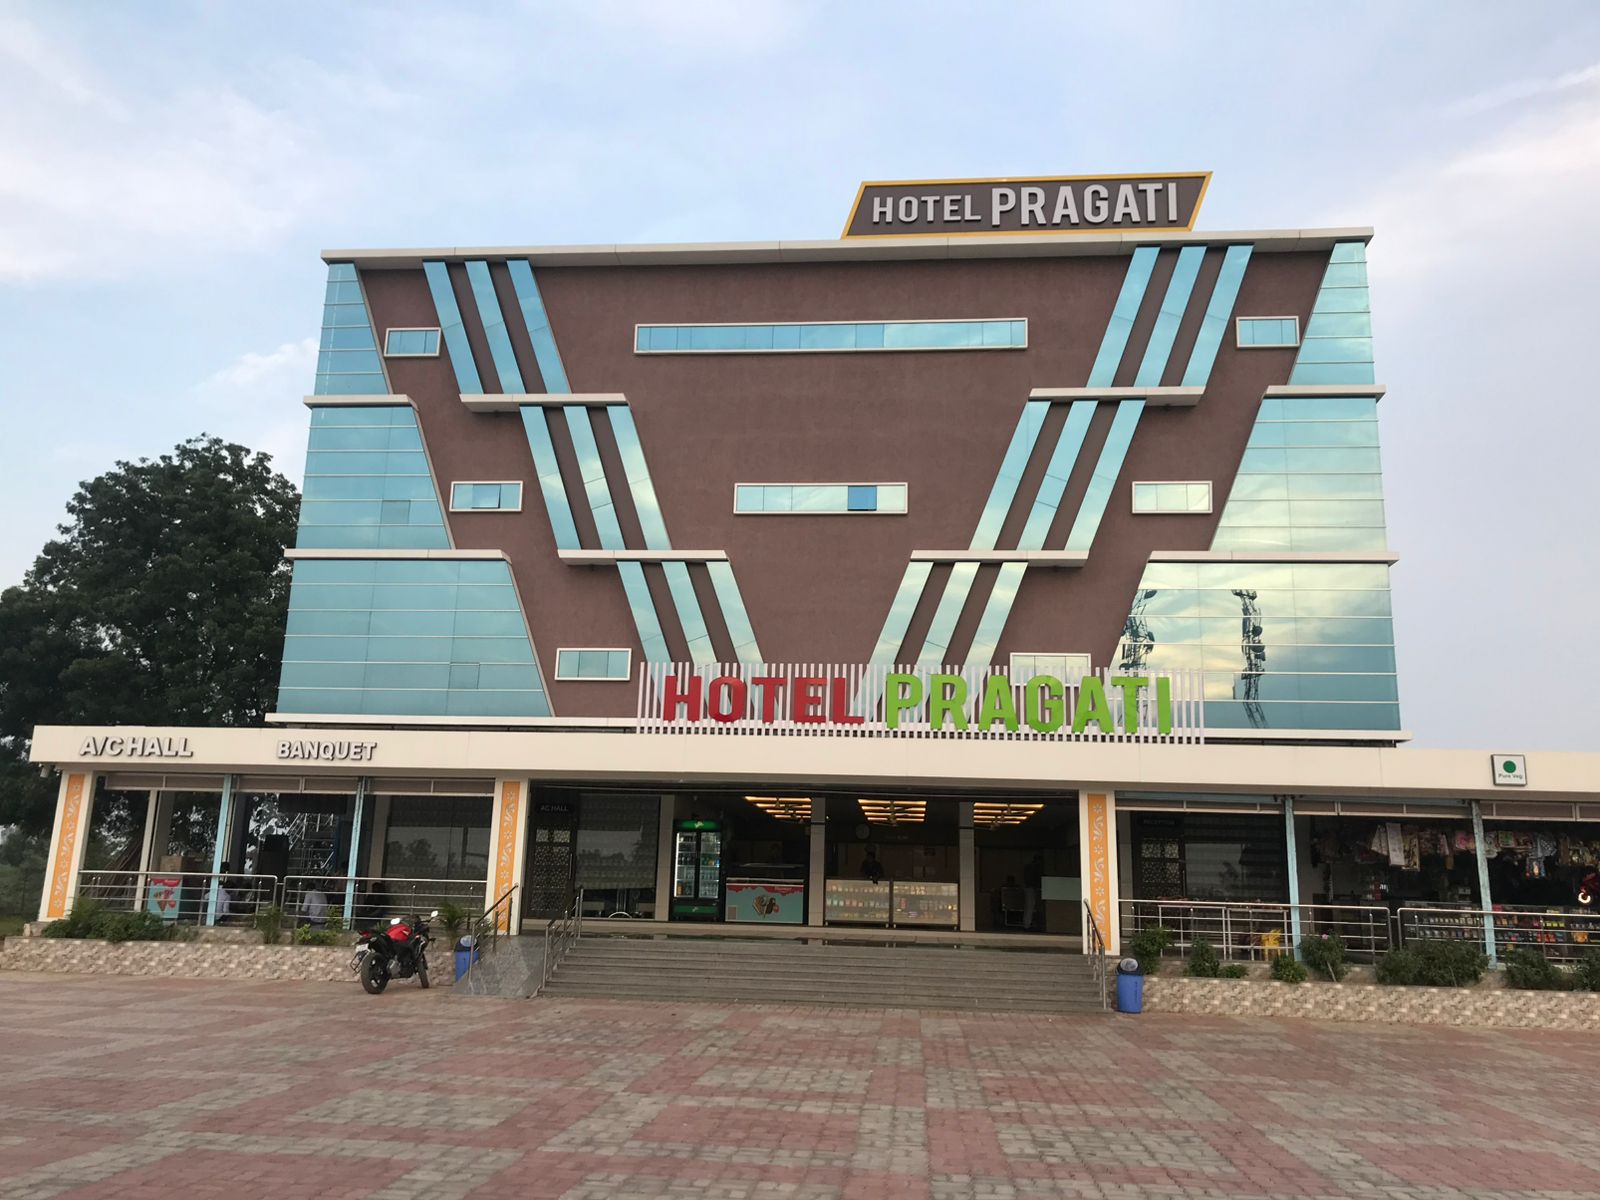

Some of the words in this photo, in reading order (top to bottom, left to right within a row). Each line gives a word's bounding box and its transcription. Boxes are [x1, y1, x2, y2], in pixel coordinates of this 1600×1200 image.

[872, 194, 982, 223] HOTEL
[991, 182, 1178, 227] PRAGATI
[663, 675, 865, 724] HOTEL
[886, 672, 1172, 735] PRAGATI
[80, 736, 124, 757] A/C
[127, 737, 194, 758] HALL
[278, 740, 378, 761] BANQUET
